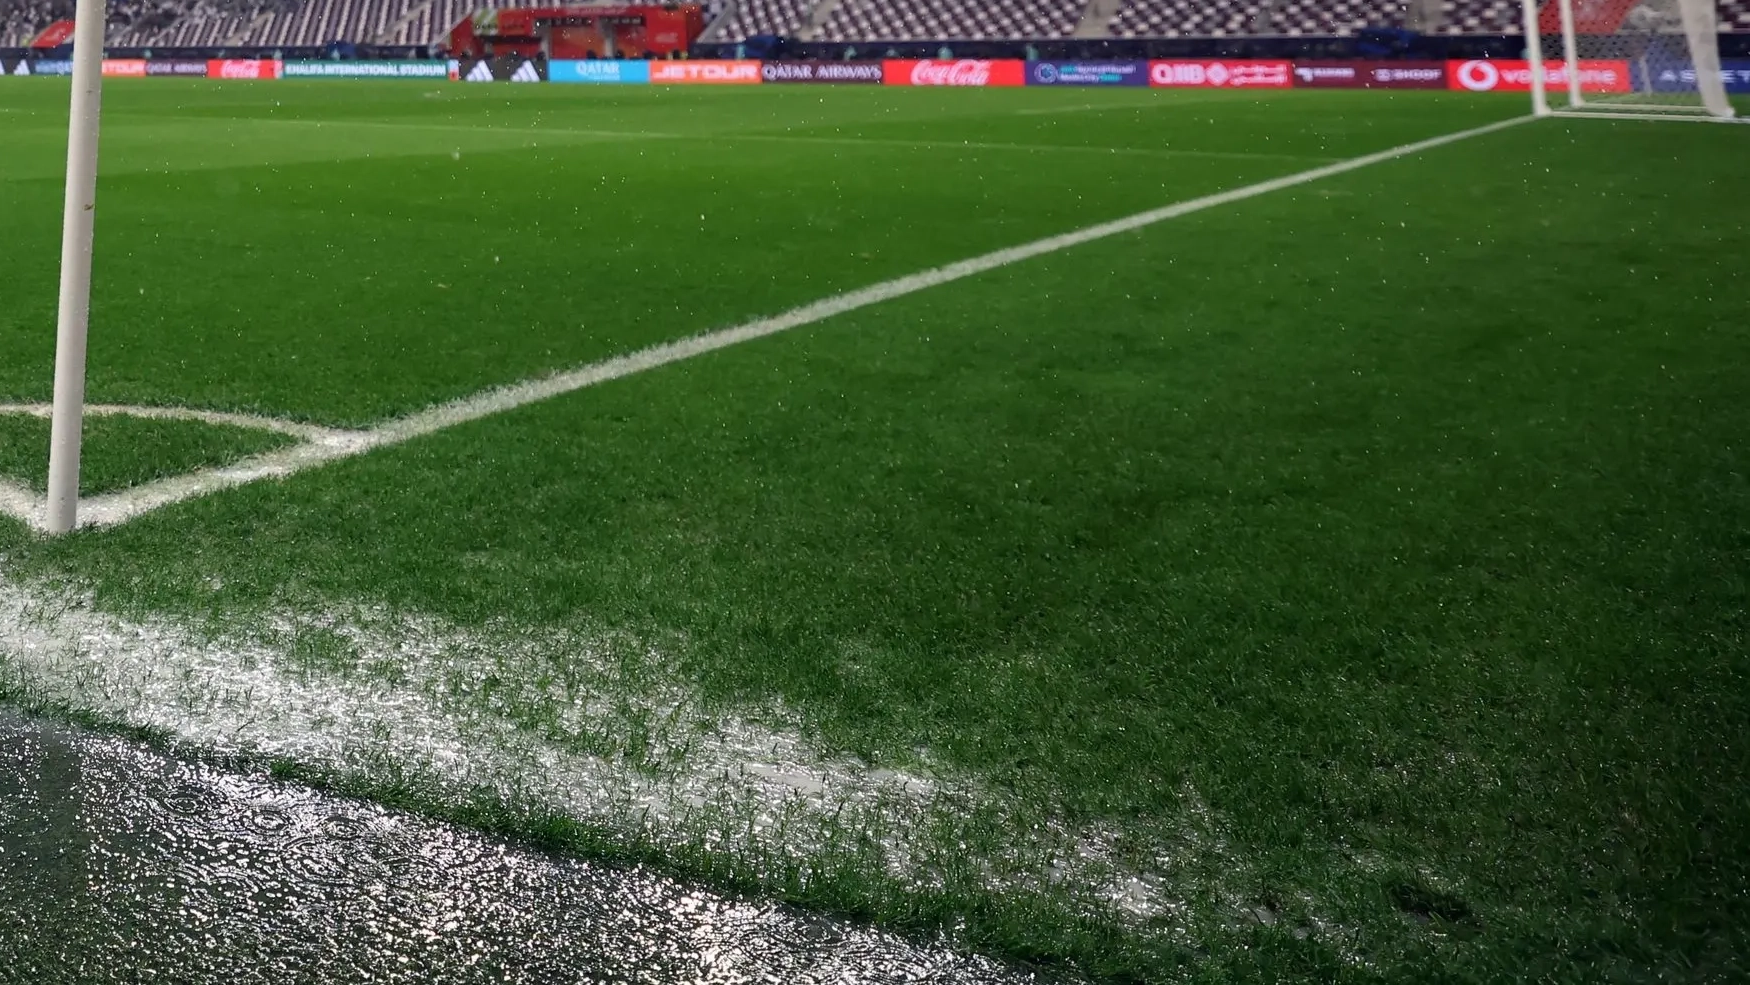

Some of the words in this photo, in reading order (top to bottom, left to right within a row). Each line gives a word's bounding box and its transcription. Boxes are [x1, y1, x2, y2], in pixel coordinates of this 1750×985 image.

[325, 63, 399, 76] INTERNATIONAL
[400, 64, 446, 76] STADIUM
[575, 61, 620, 75] QATAR
[652, 66, 759, 79] JETOUR
[762, 65, 812, 80] QATAR
[816, 65, 882, 79] AIRWAYS
[911, 59, 990, 85] Coca-Cola
[1658, 70, 1750, 84] ASET
